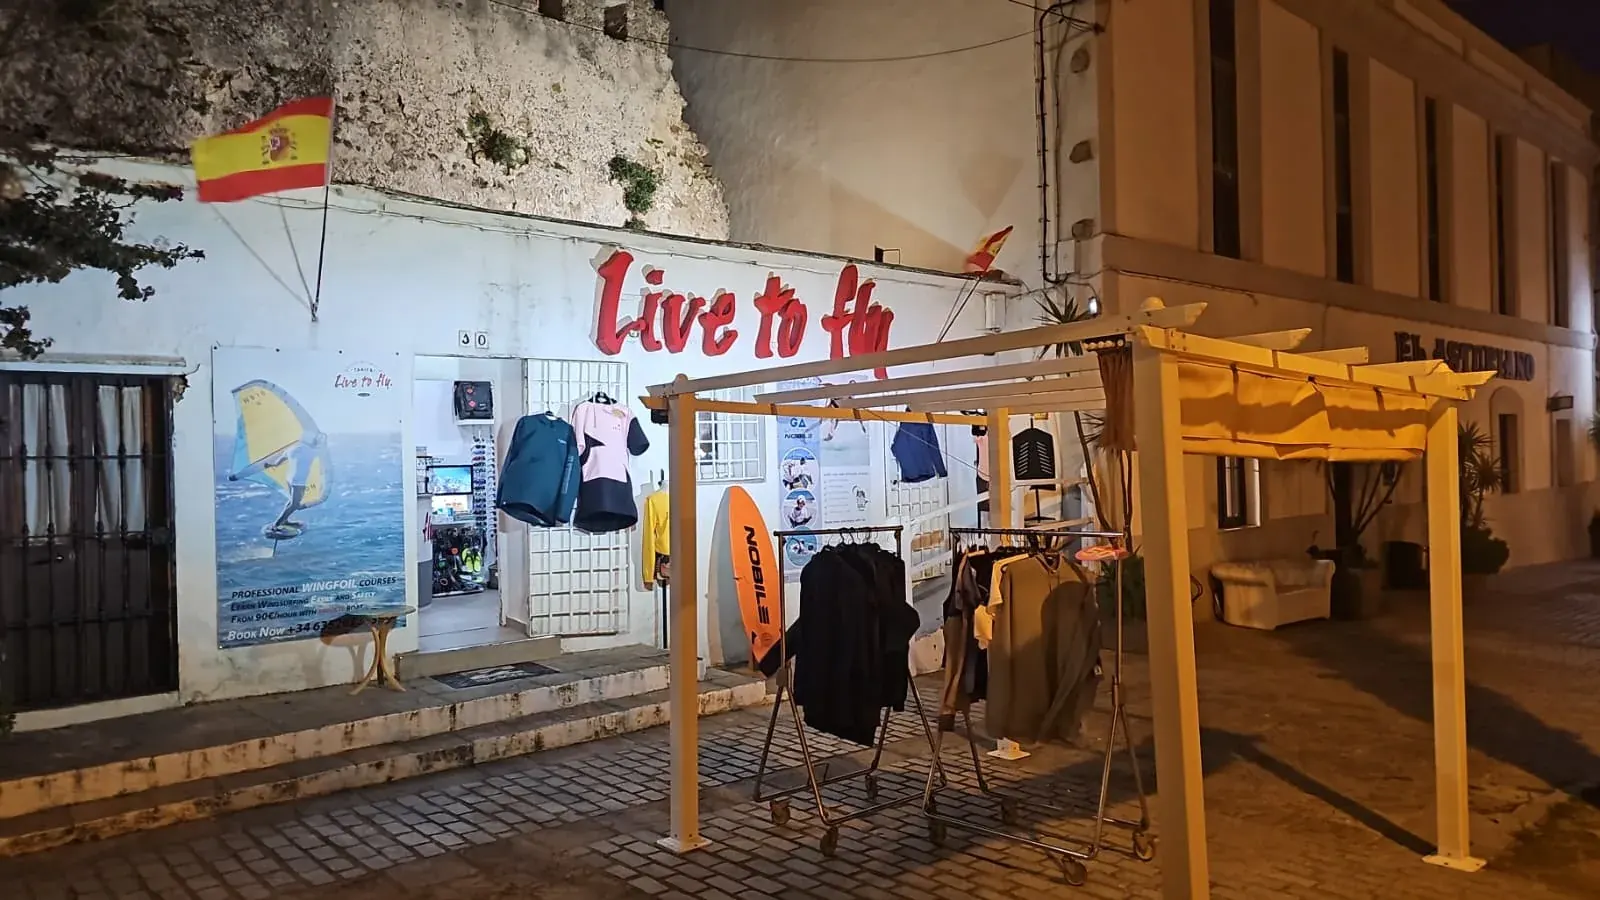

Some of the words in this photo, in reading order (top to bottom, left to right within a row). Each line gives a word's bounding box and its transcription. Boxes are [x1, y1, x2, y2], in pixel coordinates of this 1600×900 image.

[594, 249, 738, 356] Live
[754, 275, 808, 358] to
[820, 263, 895, 380] fly
[335, 374, 358, 389] Live
[361, 375, 373, 388] to
[743, 525, 770, 625] NOBILE
[231, 586, 300, 599] PROFESSIONAL
[302, 579, 358, 593] WINGFOIL
[359, 576, 397, 588] COURSES
[231, 615, 254, 623] FROM
[299, 608, 317, 617] WITH
[227, 630, 257, 641] BOOK
[259, 626, 286, 638] NOW
[287, 623, 311, 634] +34
